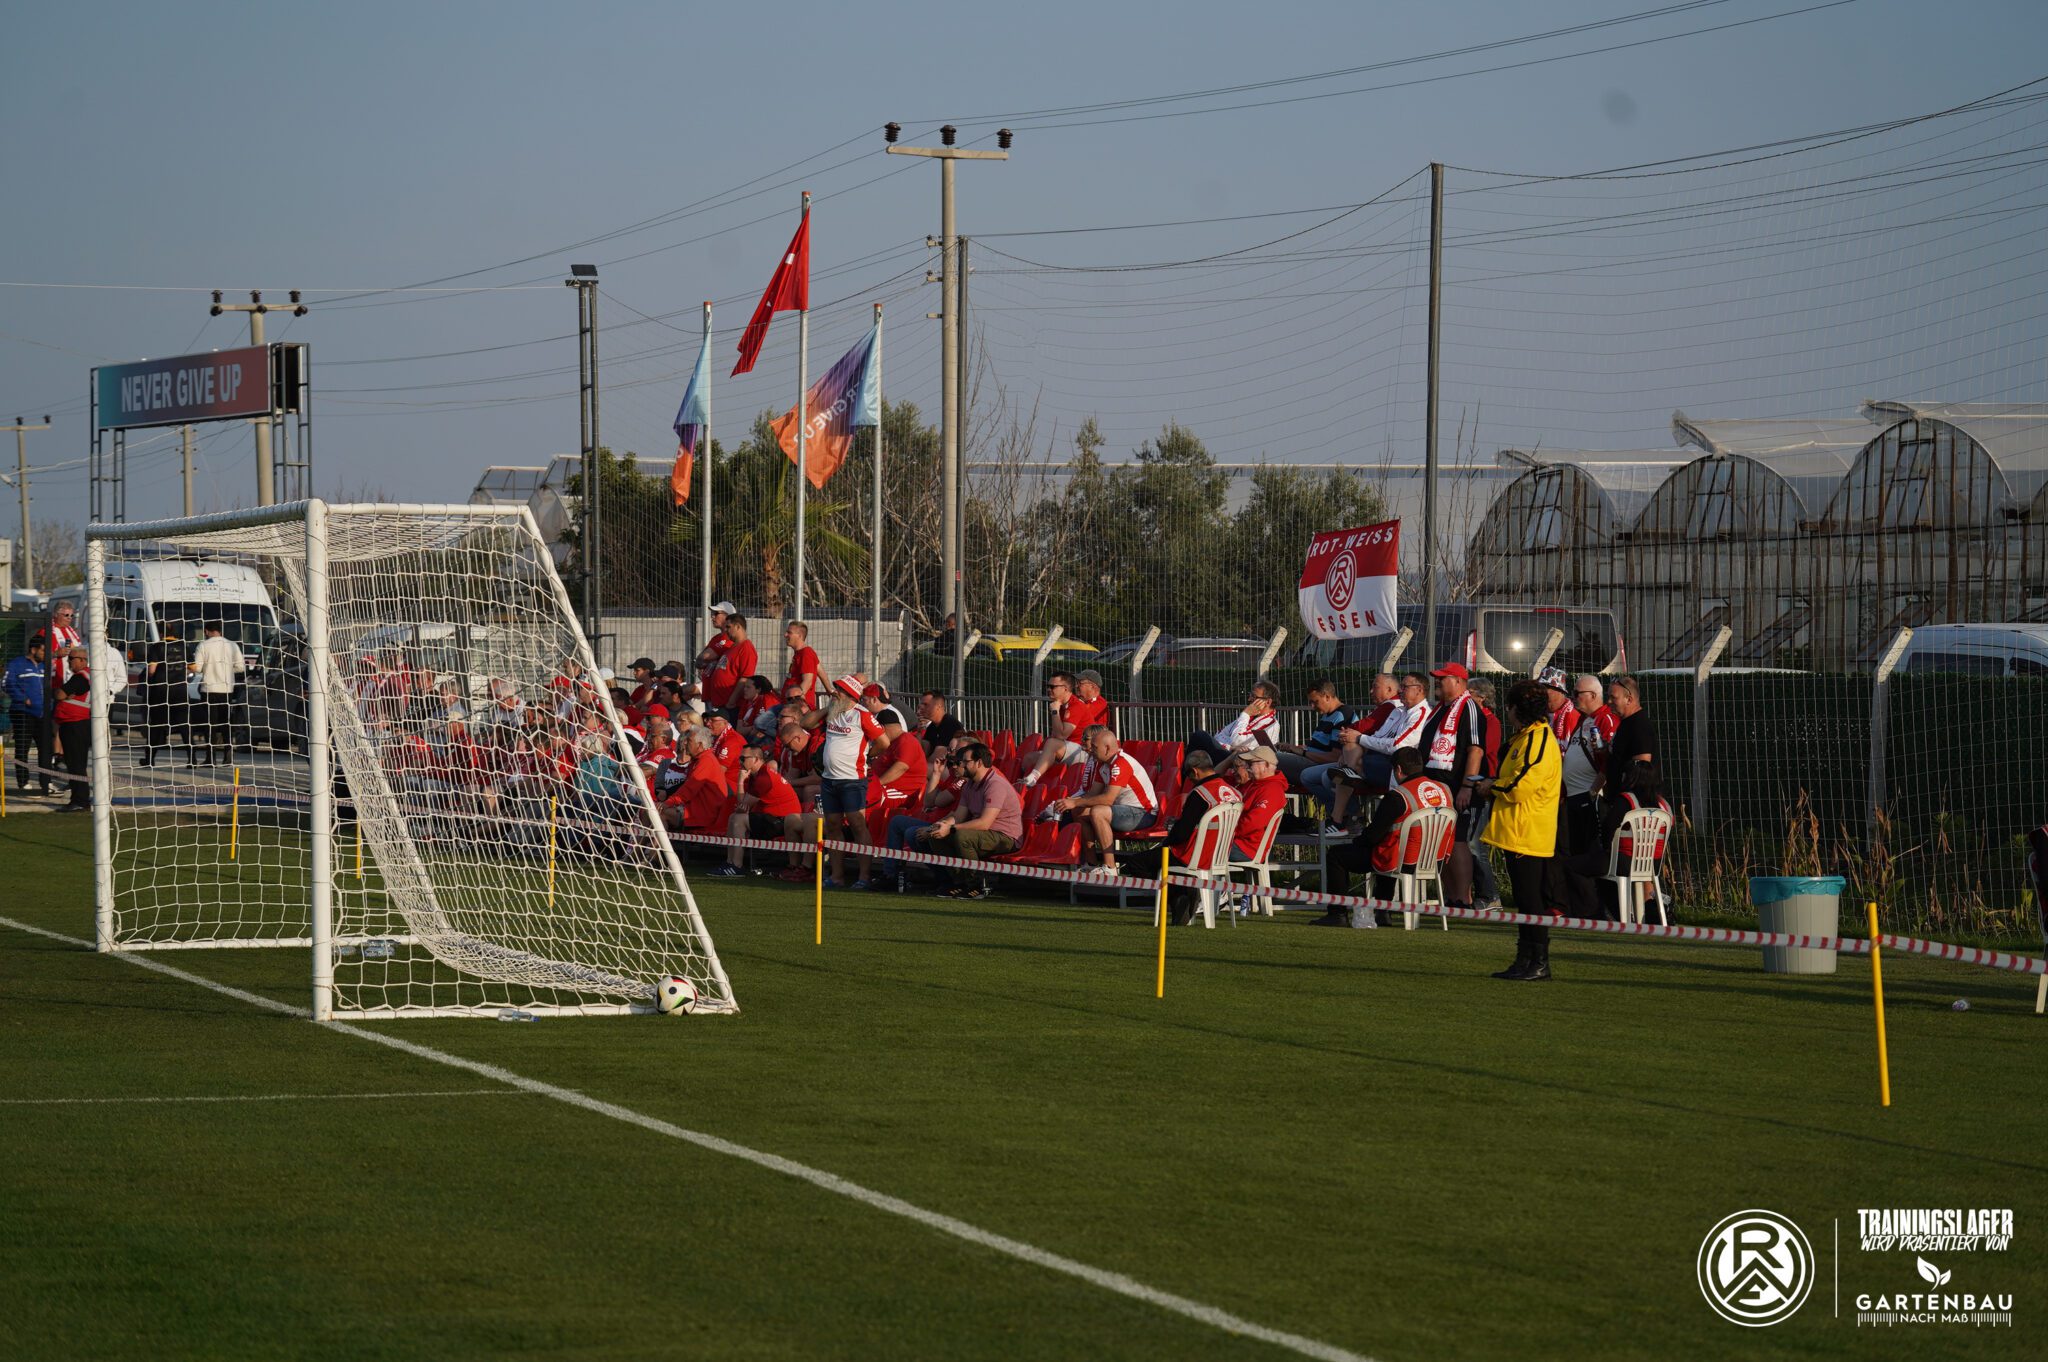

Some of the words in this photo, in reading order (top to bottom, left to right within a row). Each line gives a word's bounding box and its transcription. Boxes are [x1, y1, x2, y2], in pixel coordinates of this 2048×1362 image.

[121, 371, 173, 413] NEVER
[176, 366, 215, 406] GIVE
[219, 363, 242, 401] UP
[1317, 610, 1377, 633] ESSEN
